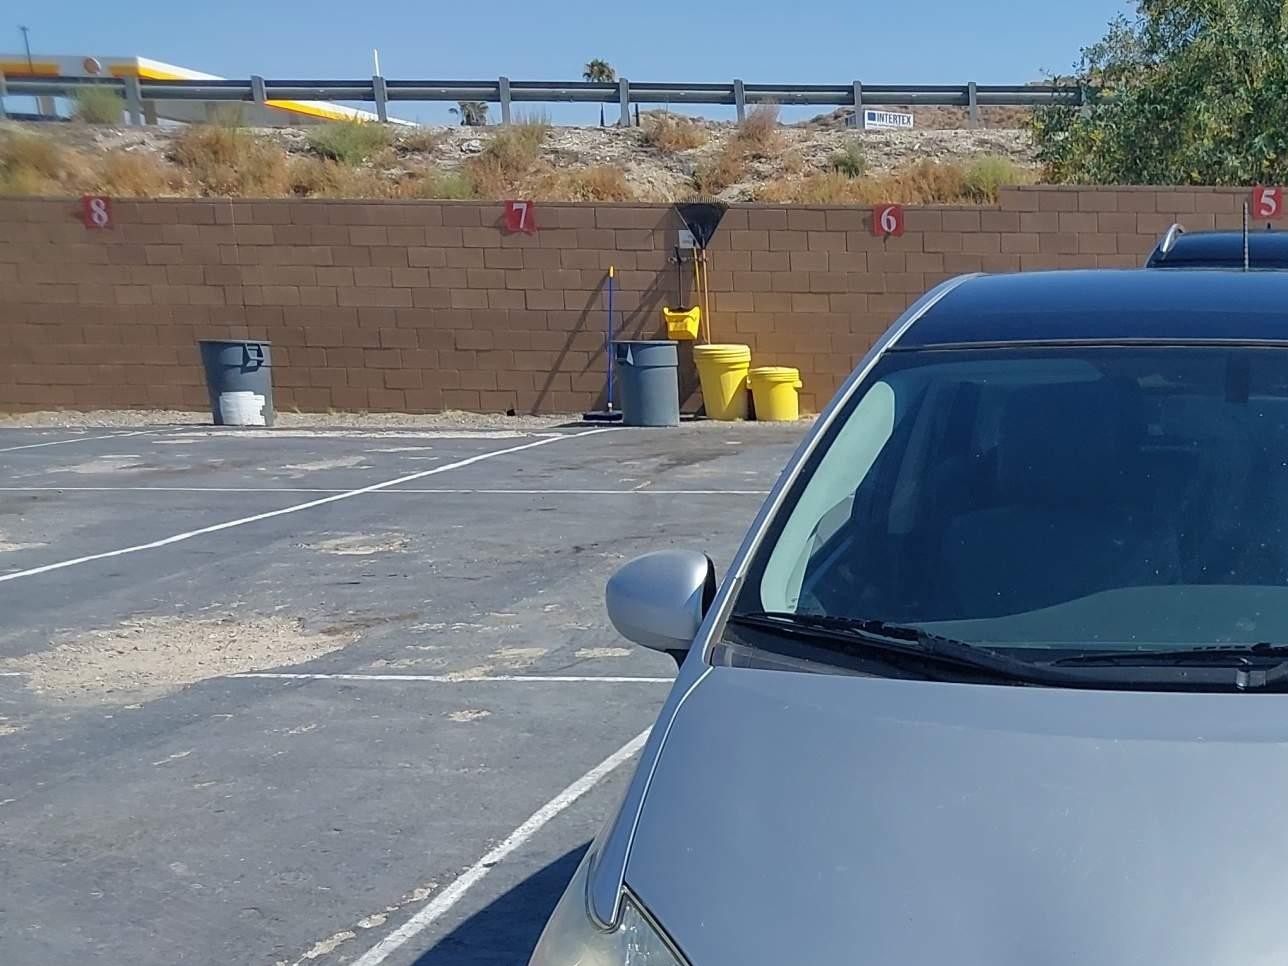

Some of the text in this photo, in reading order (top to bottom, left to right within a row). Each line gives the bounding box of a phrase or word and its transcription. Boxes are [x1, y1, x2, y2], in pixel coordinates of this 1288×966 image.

[877, 112, 911, 126] INTERTEX
[91, 199, 108, 224] 8
[512, 203, 527, 228] 7
[1261, 190, 1277, 216] 5
[881, 207, 897, 233] 6
